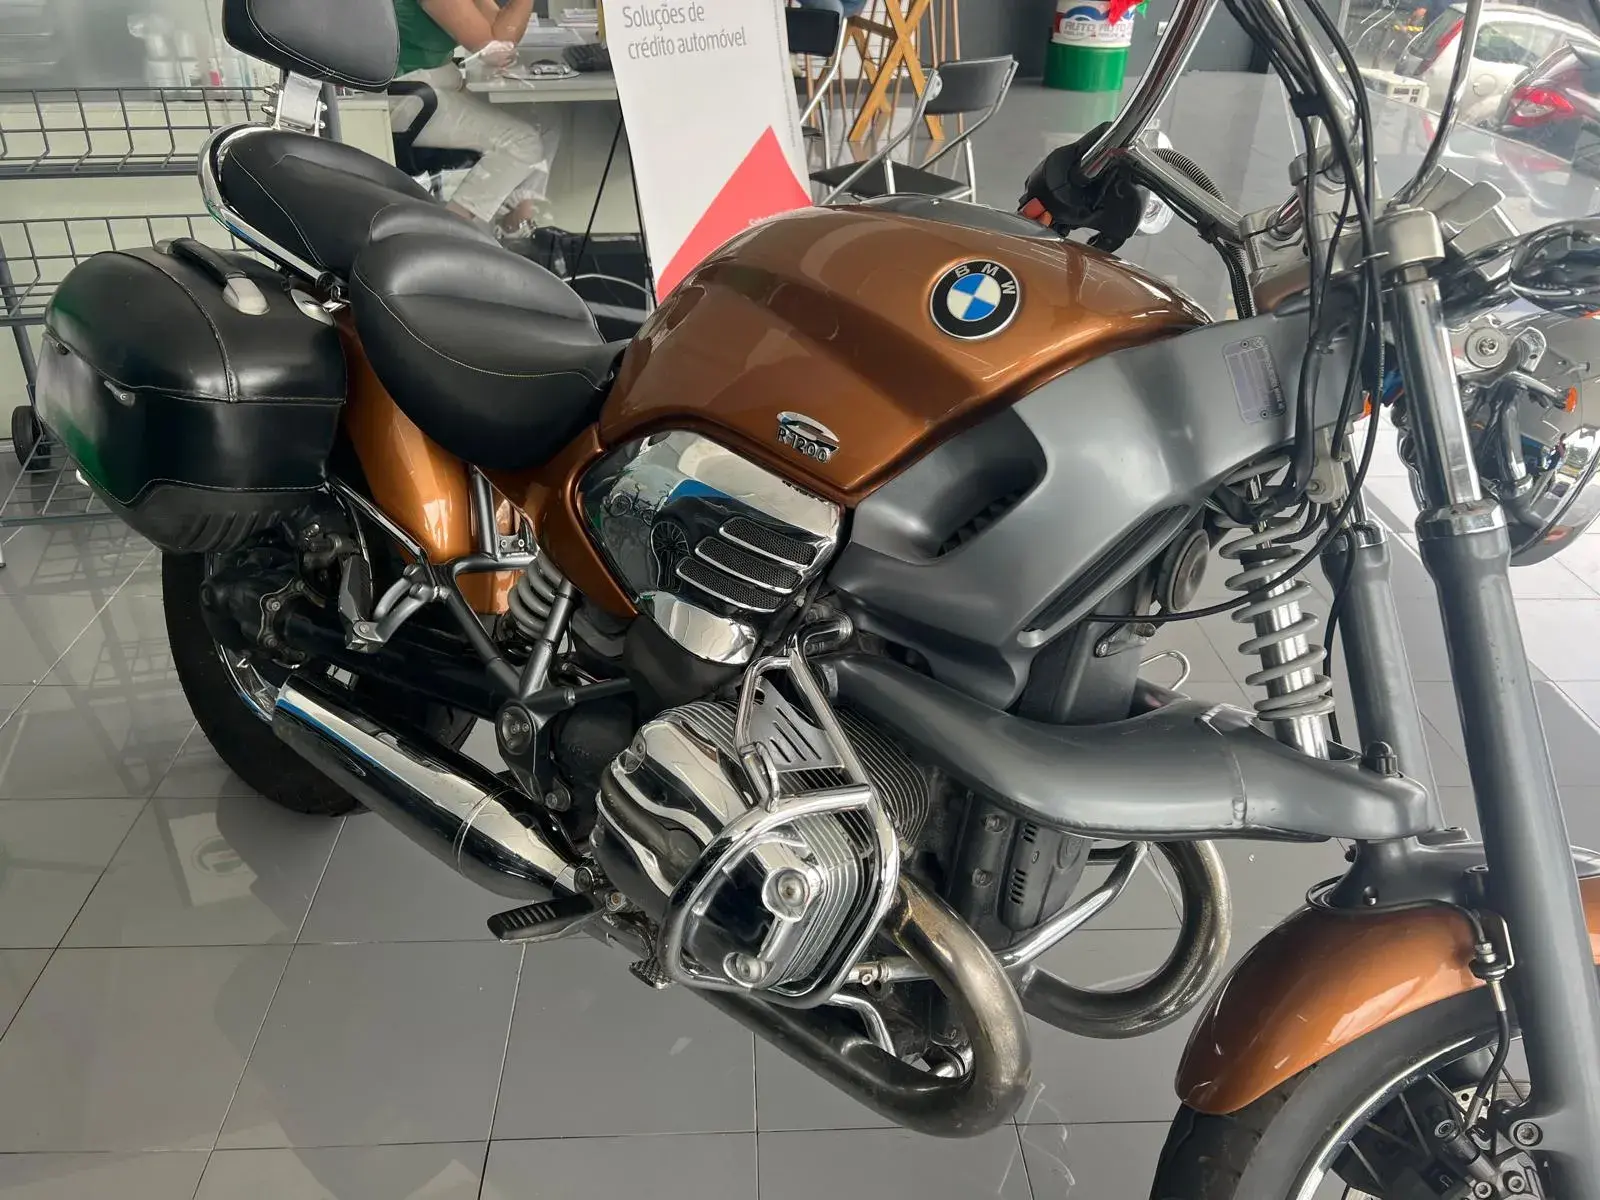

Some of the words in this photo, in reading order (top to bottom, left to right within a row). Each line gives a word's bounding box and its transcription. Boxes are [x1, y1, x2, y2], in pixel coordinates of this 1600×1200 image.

[622, 3, 686, 32] Soluções
[688, 2, 705, 22] de
[628, 35, 675, 60] crédito
[677, 26, 747, 54] automóvel
[954, 262, 1017, 295] BMW
